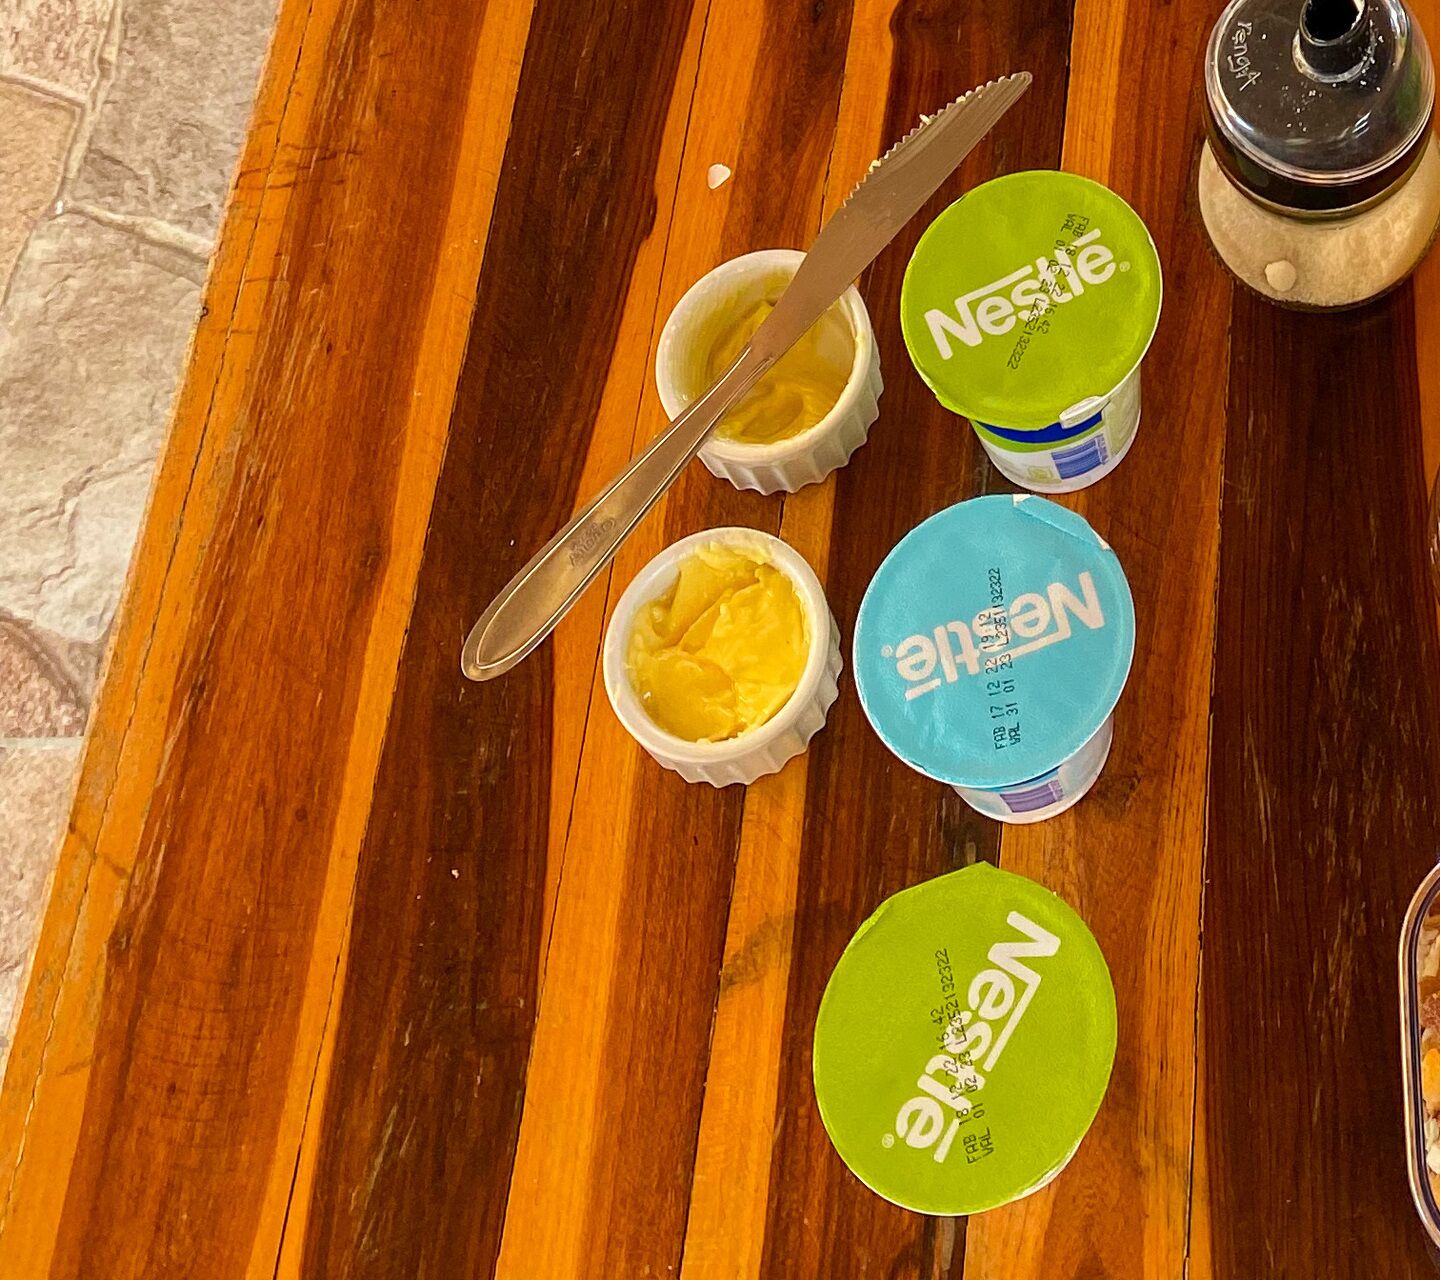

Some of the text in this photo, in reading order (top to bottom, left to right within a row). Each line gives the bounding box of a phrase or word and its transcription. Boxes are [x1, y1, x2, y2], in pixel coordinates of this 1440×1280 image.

[924, 228, 1116, 361] Nestlé
[895, 571, 1106, 701] Nestlé
[895, 911, 1061, 1163] Nestlé
